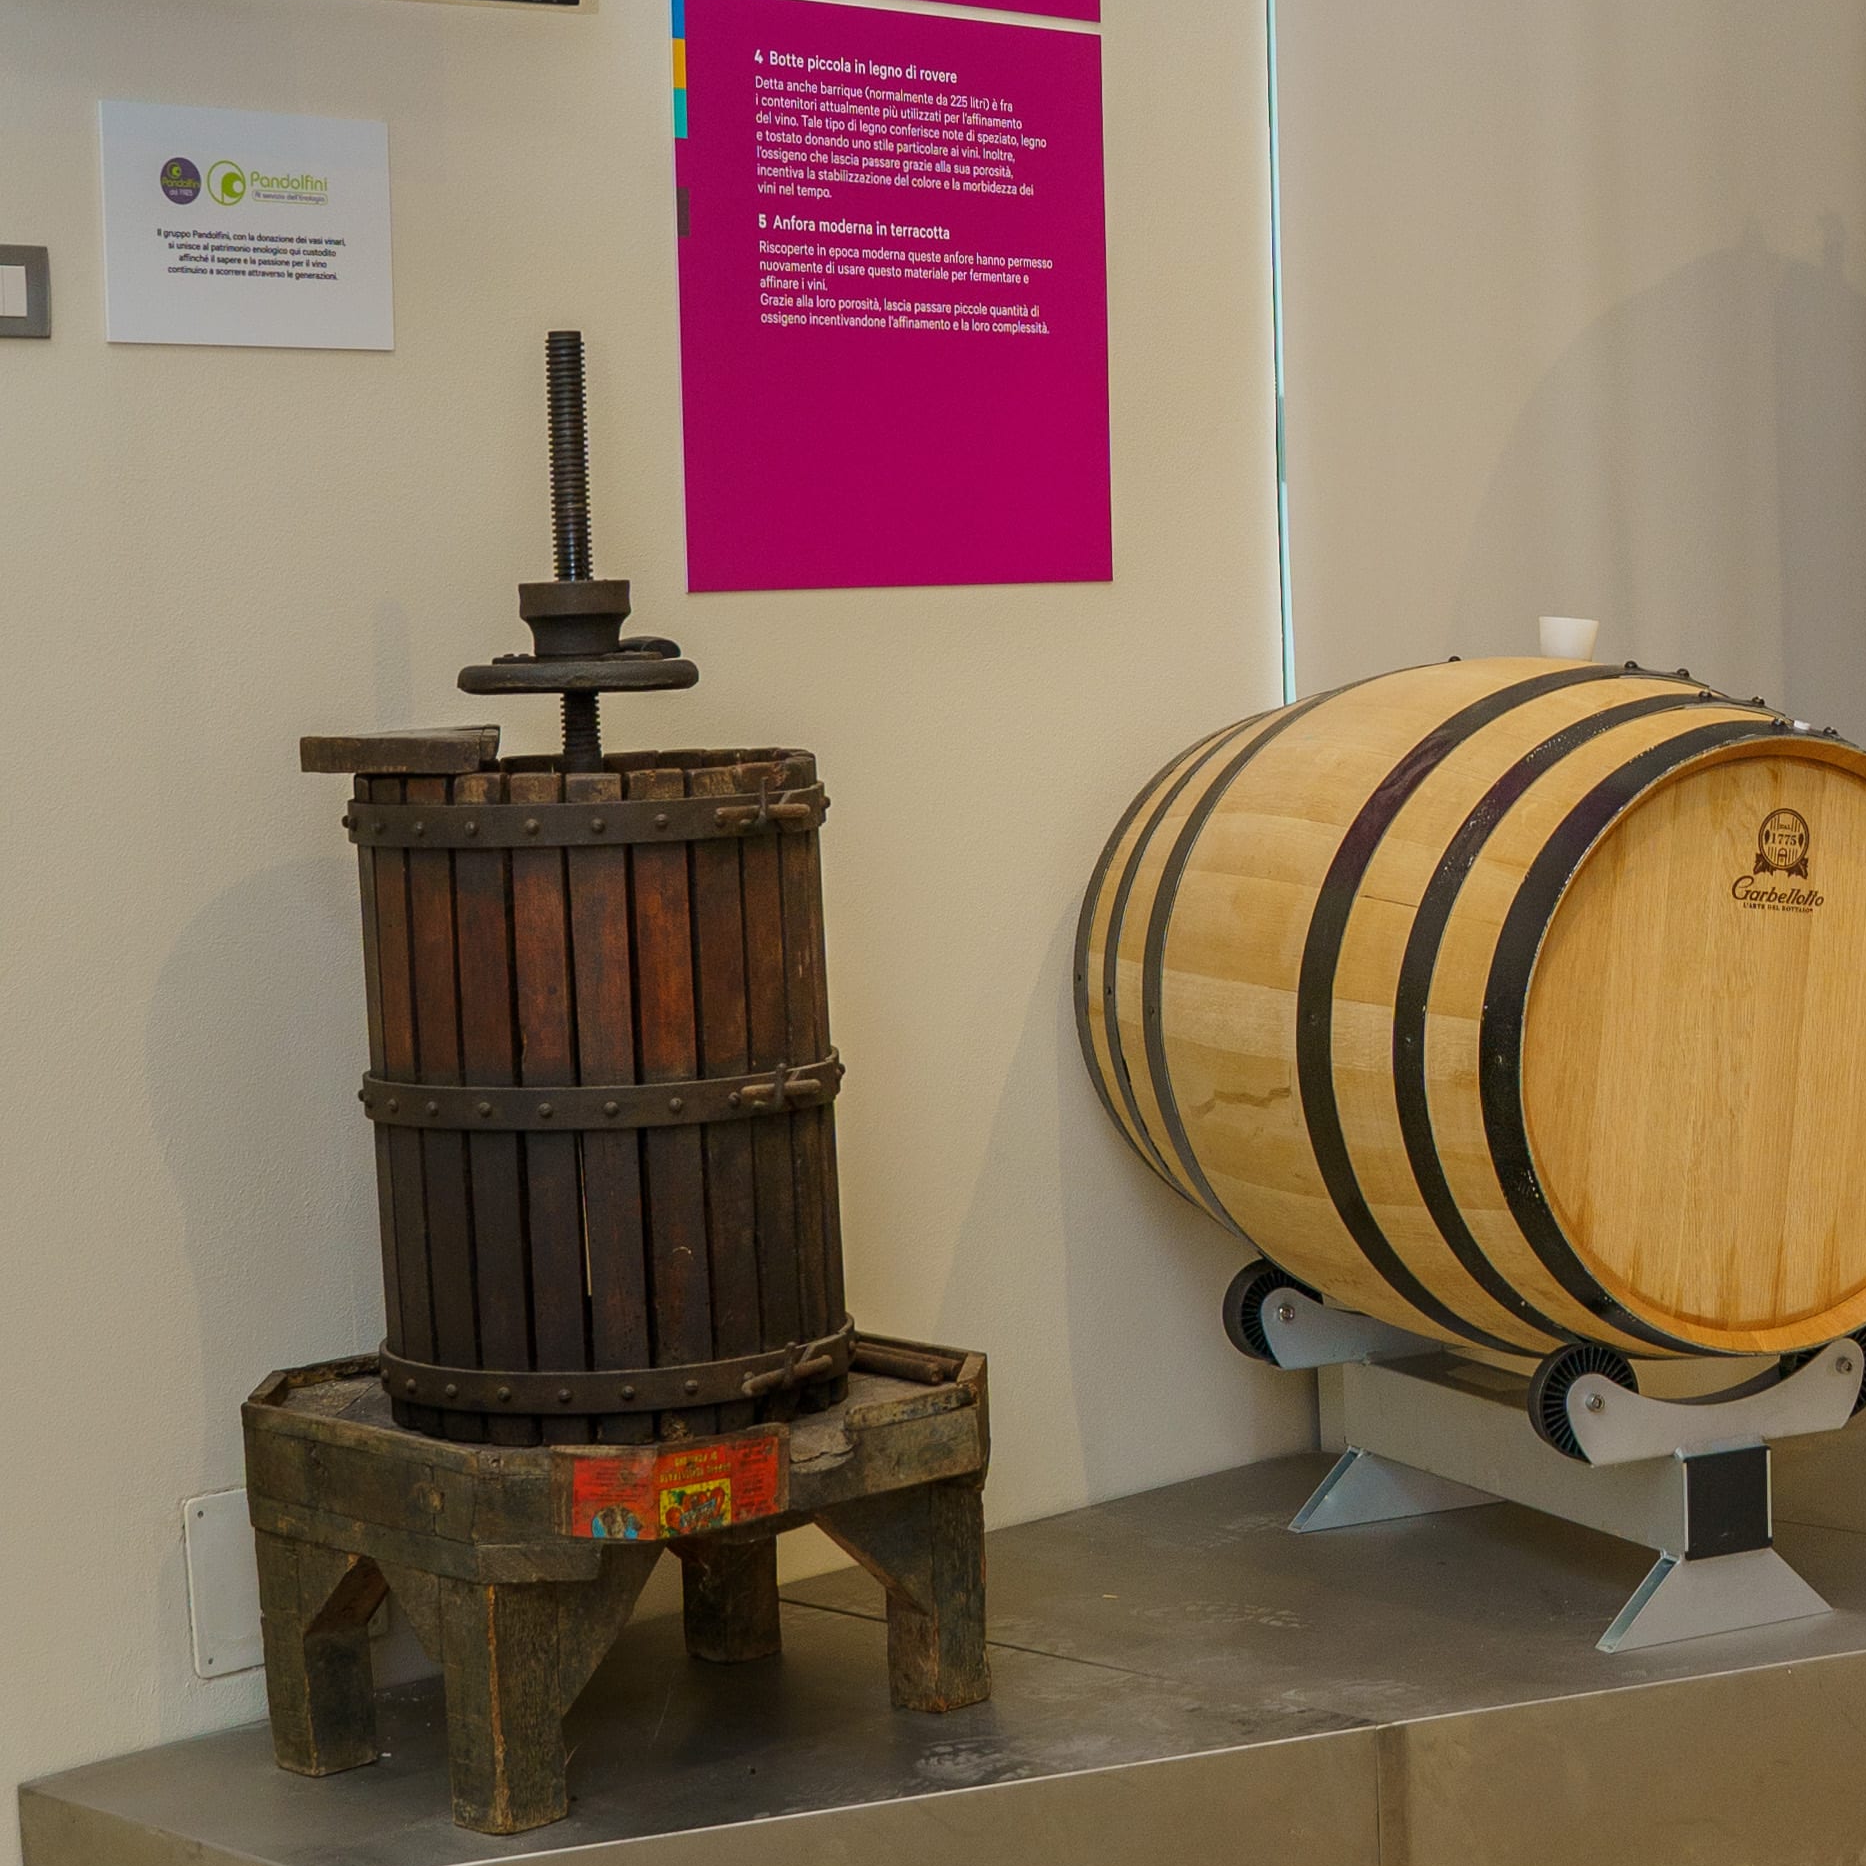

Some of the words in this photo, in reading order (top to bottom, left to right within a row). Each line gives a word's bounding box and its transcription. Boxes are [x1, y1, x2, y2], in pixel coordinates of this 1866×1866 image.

[754, 47, 763, 64] 4
[769, 48, 804, 68] Botte
[807, 53, 851, 73] piccola
[854, 57, 865, 74] in
[868, 58, 902, 80] legno
[905, 62, 916, 80] di
[919, 68, 957, 84] rovere
[755, 75, 784, 90] Detta
[786, 80, 817, 93] anche
[820, 81, 862, 99] barrique
[864, 85, 933, 104] (normalmente
[935, 92, 948, 106] da
[950, 94, 968, 107] 225
[970, 95, 989, 111] litri)
[991, 98, 997, 110] è
[999, 98, 1012, 112] fra
[755, 92, 758, 105] i
[761, 95, 817, 110] contenitori
[819, 100, 880, 116] attualmente
[882, 104, 898, 120] più
[900, 106, 941, 122] utilizzati
[944, 113, 960, 125] per
[962, 111, 1022, 129] l'affinamento
[251, 171, 328, 192] Pandolfini
[156, 228, 161, 236] Il
[163, 230, 191, 239] gruppo
[247, 232, 255, 241] la
[256, 233, 294, 243] donazione
[295, 235, 307, 244] dei
[308, 236, 323, 244] vasi
[758, 211, 767, 228] 5
[772, 212, 815, 231] Anfora
[818, 216, 873, 235] moderna
[876, 219, 887, 236] in
[890, 221, 950, 240] terracotta
[168, 240, 174, 249] si
[176, 241, 200, 250] unisce
[202, 242, 209, 250] al
[210, 243, 251, 252] patrimonio
[252, 245, 288, 255] enologico
[288, 246, 301, 256] qui
[302, 248, 336, 257] custodito
[178, 253, 209, 262] affinché
[210, 254, 215, 262] il
[216, 256, 241, 265] sapere
[249, 256, 256, 264] la
[257, 257, 290, 266] passione
[291, 260, 303, 268] per
[305, 258, 310, 267] il
[311, 259, 327, 268] vino
[759, 239, 814, 257] Riscoperte
[816, 243, 826, 256] in
[828, 247, 859, 259] epoca
[862, 246, 905, 260] moderna
[907, 250, 941, 263] queste
[943, 250, 974, 264] anfore
[976, 252, 1005, 266] hanno
[1007, 257, 1052, 269] permesso
[167, 265, 207, 274] continuino
[215, 268, 246, 276] scorrere
[247, 268, 285, 278] attraverso
[286, 269, 293, 278] le
[759, 260, 823, 273] nuovamente
[825, 261, 835, 274] di
[837, 265, 865, 275] usare
[867, 265, 902, 278] questo
[904, 266, 949, 279] materiale
[951, 271, 967, 283] per
[969, 268, 1021, 283] fermentare
[1022, 274, 1029, 284] e
[1772, 832, 1797, 845] 1775
[1732, 875, 1824, 906] Garbellotto
